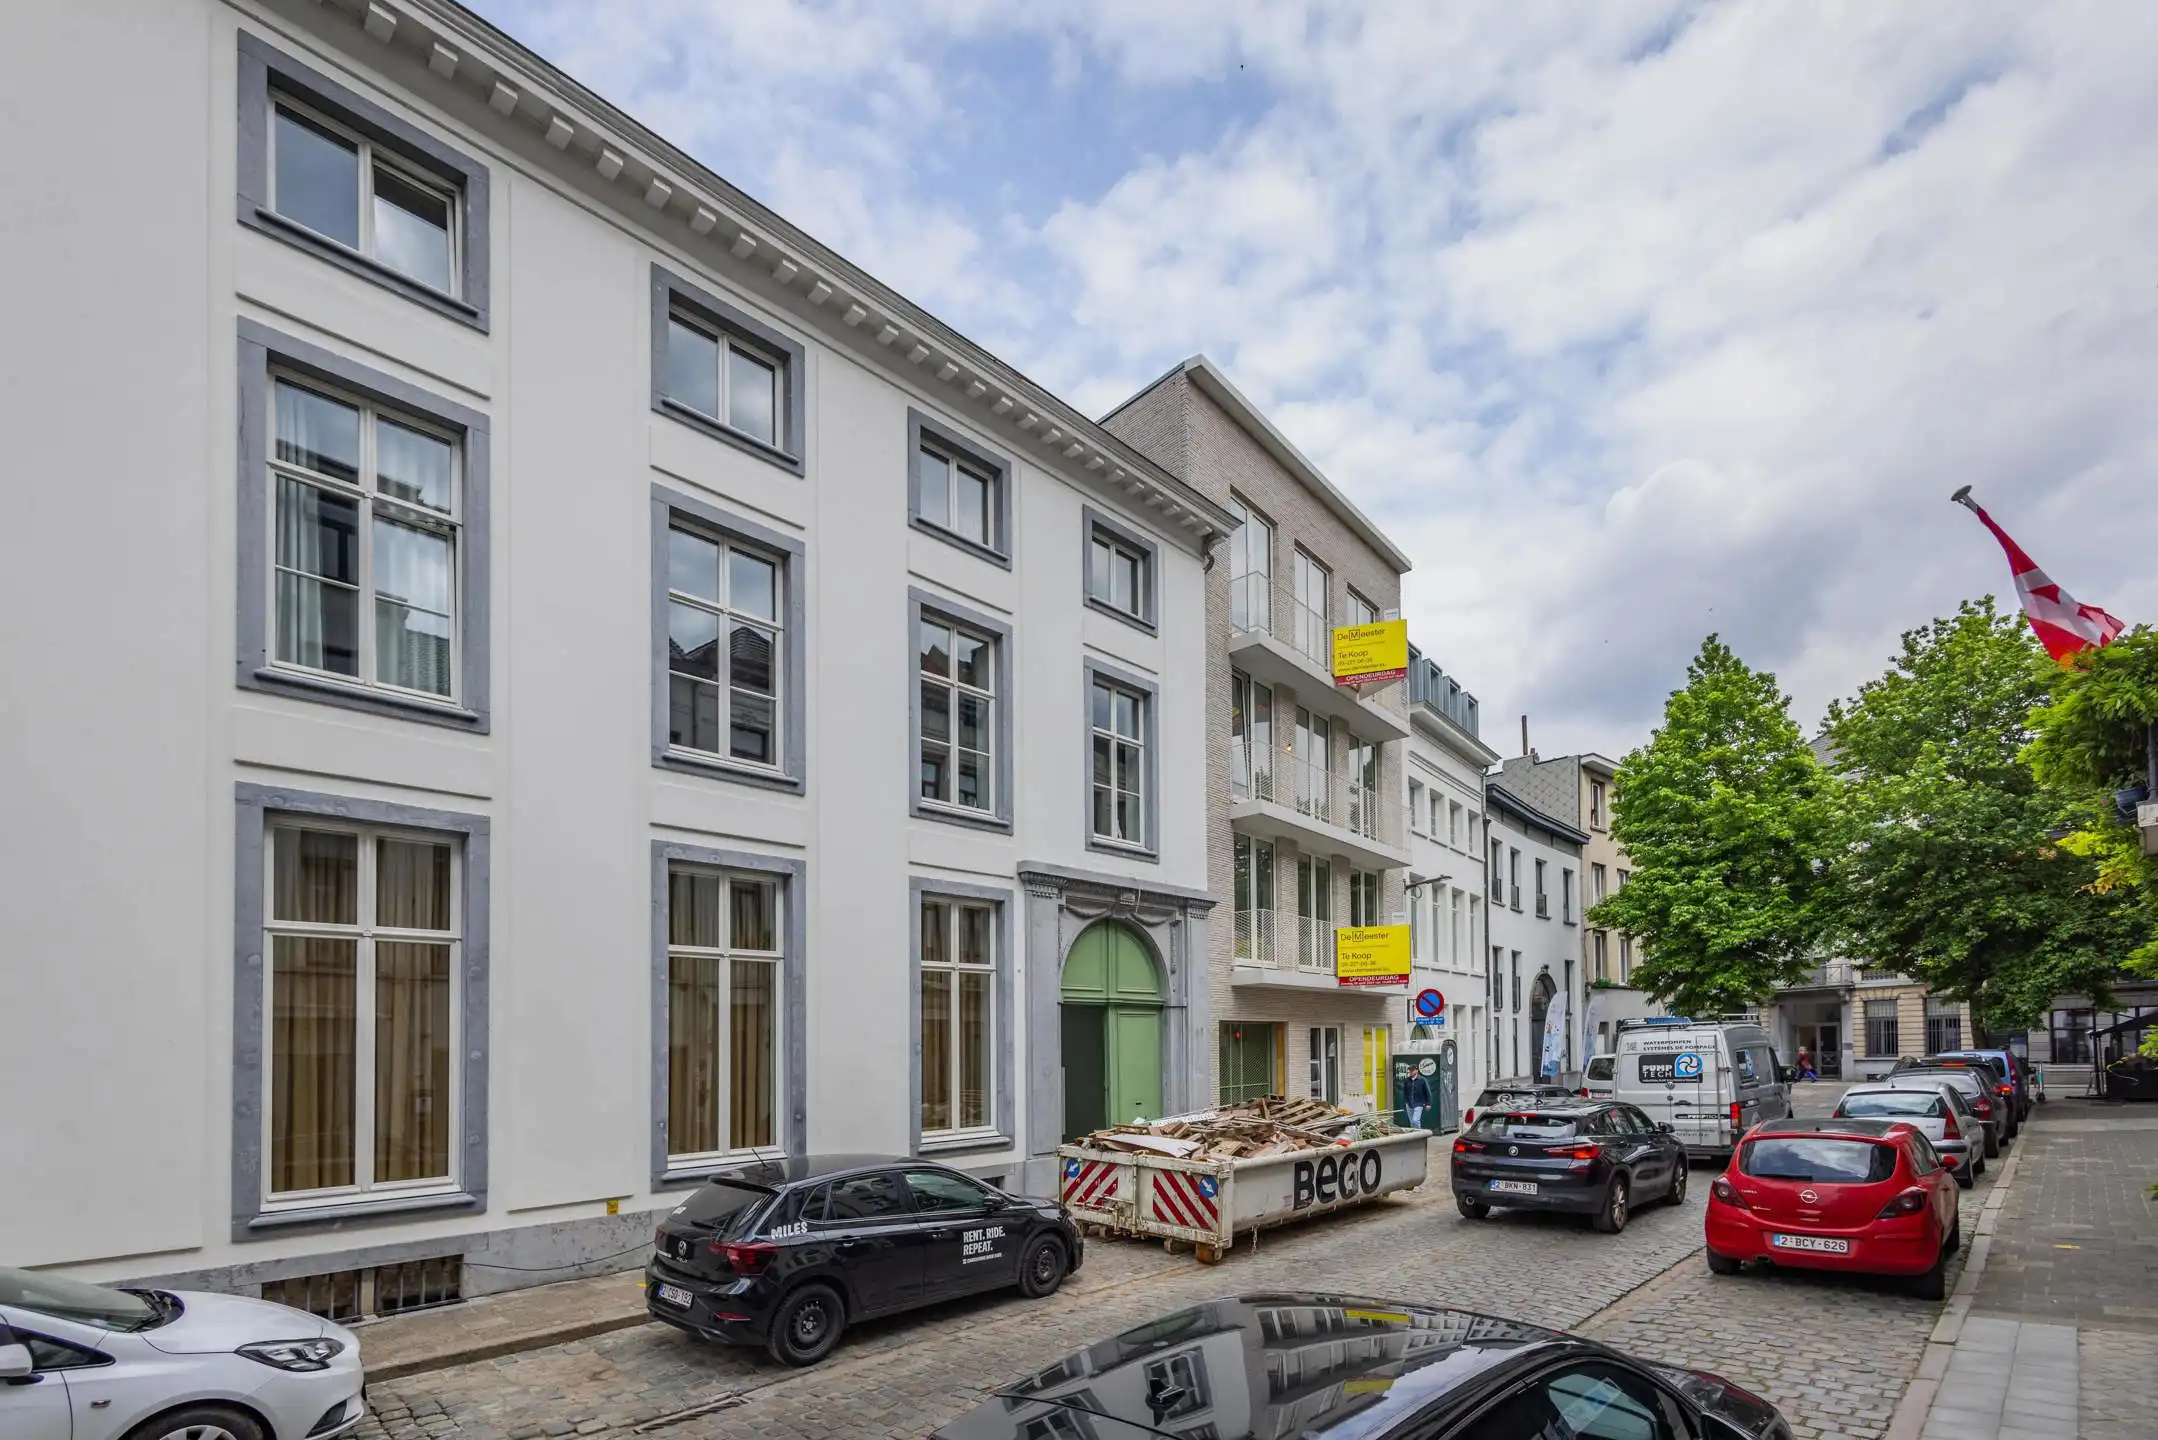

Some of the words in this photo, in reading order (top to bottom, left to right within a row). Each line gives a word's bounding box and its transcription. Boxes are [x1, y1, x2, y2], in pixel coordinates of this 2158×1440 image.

[1349, 650, 1369, 658] Koop
[1346, 670, 1396, 681] OPENDEURDAG
[771, 1221, 808, 1240] MILES
[963, 1229, 985, 1243] RENT.
[963, 1240, 993, 1255] REPEAT.
[1781, 1236, 1846, 1251] 2-BCY-626
